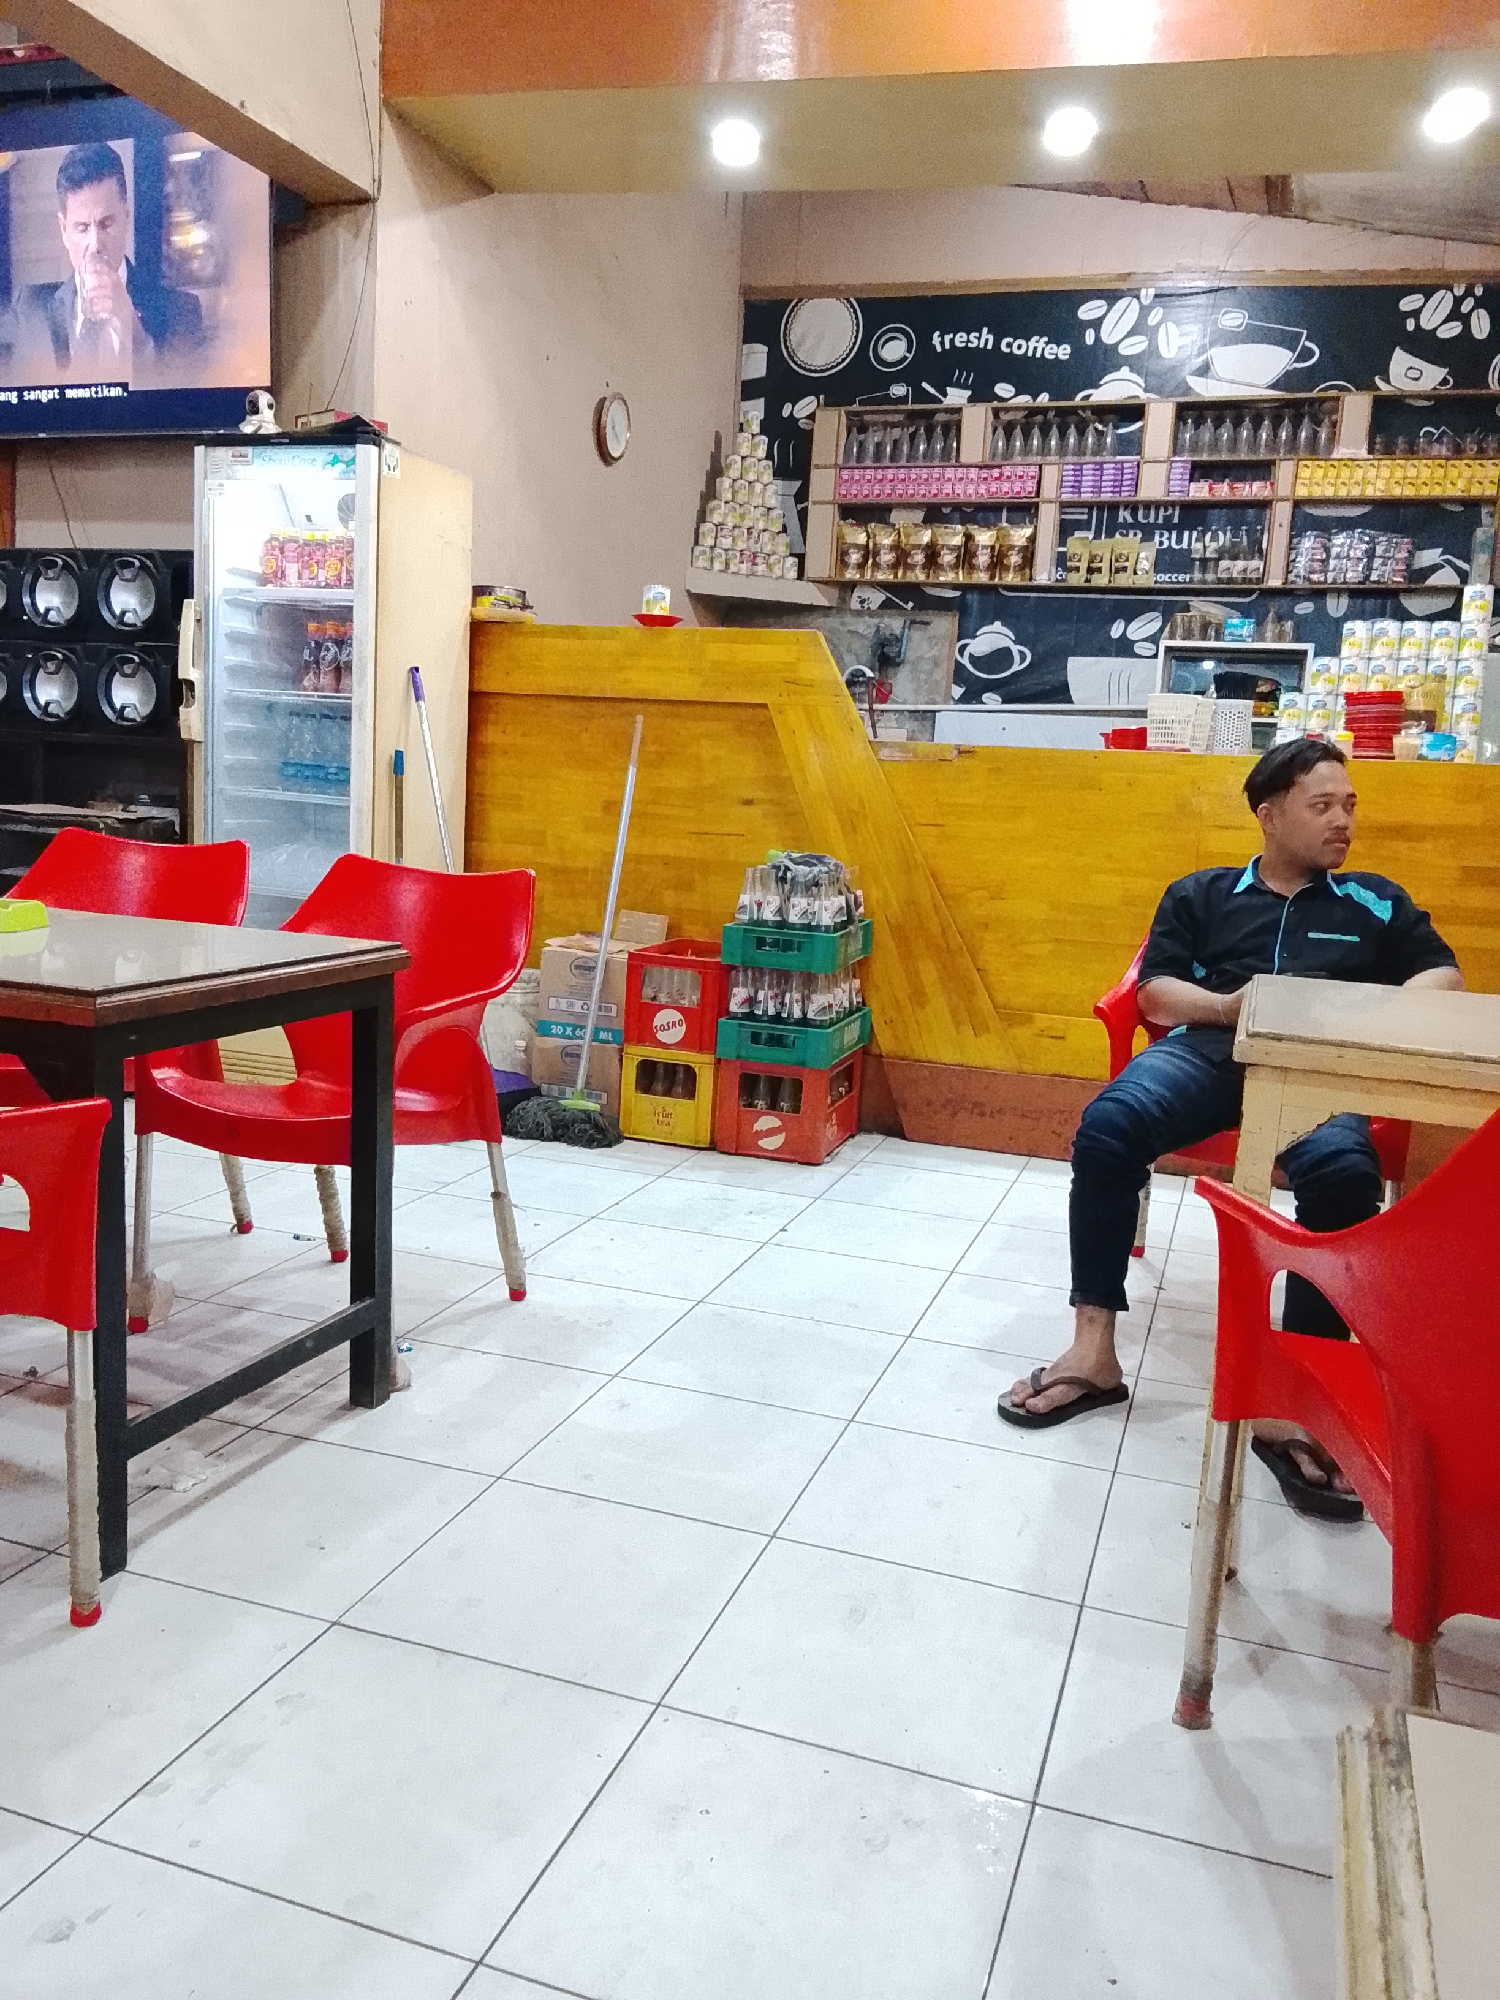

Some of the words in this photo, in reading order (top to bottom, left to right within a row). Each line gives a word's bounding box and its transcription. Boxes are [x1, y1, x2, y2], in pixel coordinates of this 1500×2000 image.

[931, 326, 994, 353] fresh
[1000, 335, 1072, 360] coffee
[22, 388, 60, 403] sangat
[64, 384, 128, 399] mematikan.
[1117, 503, 1180, 524] KUPI
[550, 1025, 564, 1035] 20
[565, 1026, 573, 1037] X
[598, 1030, 614, 1041] ML
[653, 1018, 685, 1034] SOSRO
